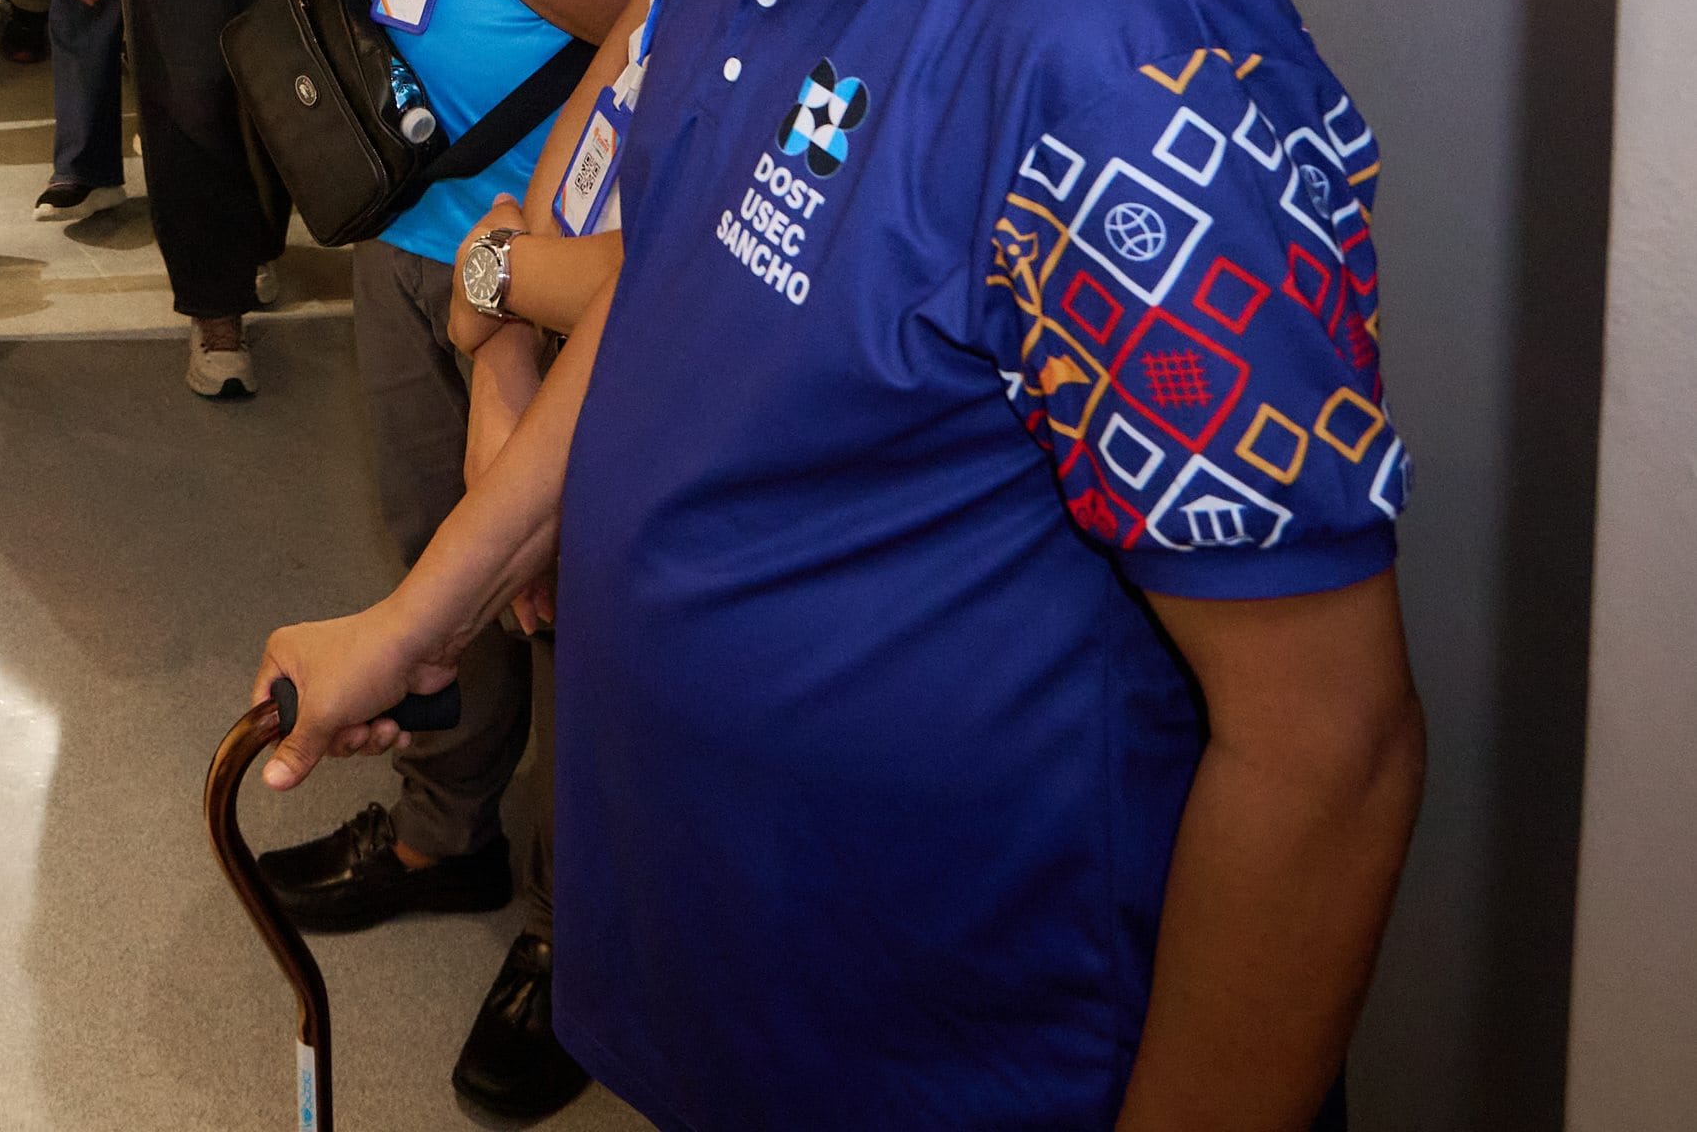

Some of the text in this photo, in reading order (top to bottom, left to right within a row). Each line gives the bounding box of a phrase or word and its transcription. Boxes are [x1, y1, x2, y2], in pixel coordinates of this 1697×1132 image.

[754, 152, 826, 219] DOST
[716, 209, 811, 306] SANCHO
[740, 187, 806, 258] USEC
